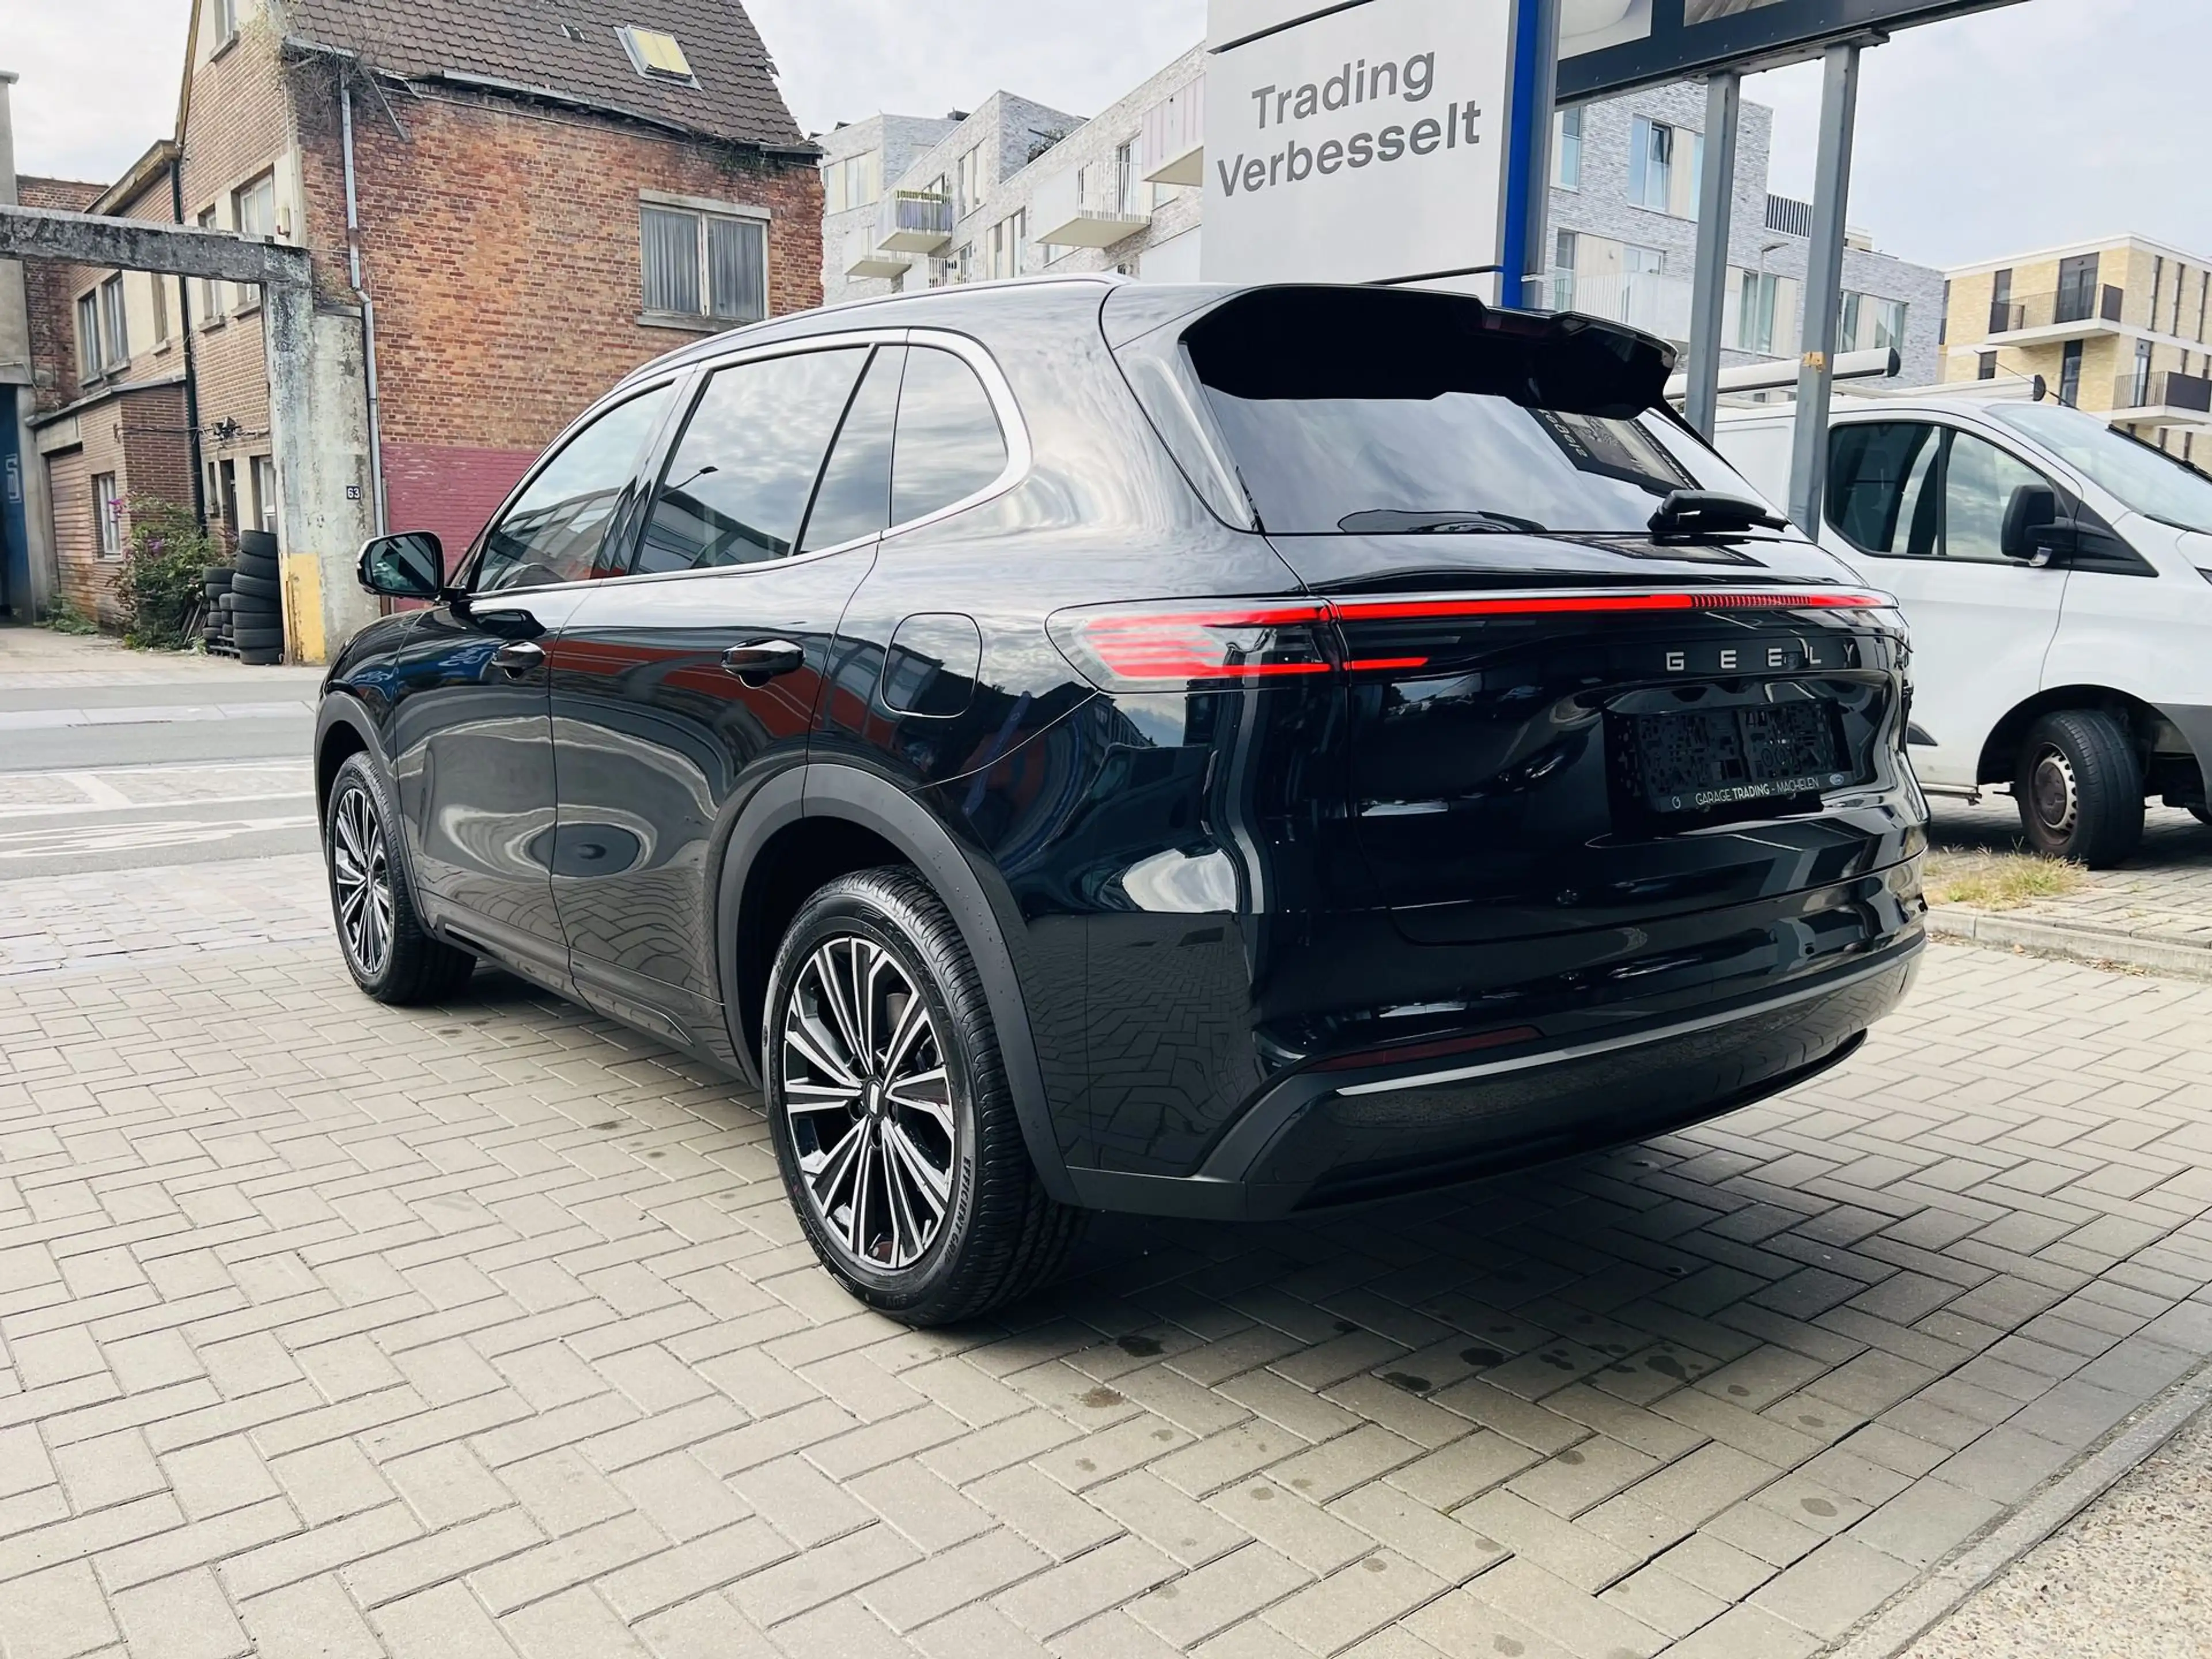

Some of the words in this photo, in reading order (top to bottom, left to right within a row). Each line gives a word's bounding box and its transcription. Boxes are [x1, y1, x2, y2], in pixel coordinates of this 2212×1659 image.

[1252, 51, 1435, 129] Trading
[1217, 100, 1481, 197] Verbesselt
[347, 487, 360, 499] 63
[1666, 644, 1854, 671] GEELY
[1695, 789, 1732, 805] GARAGE
[1732, 783, 1770, 800] TRADING
[1776, 777, 1820, 793] MACHELEN
